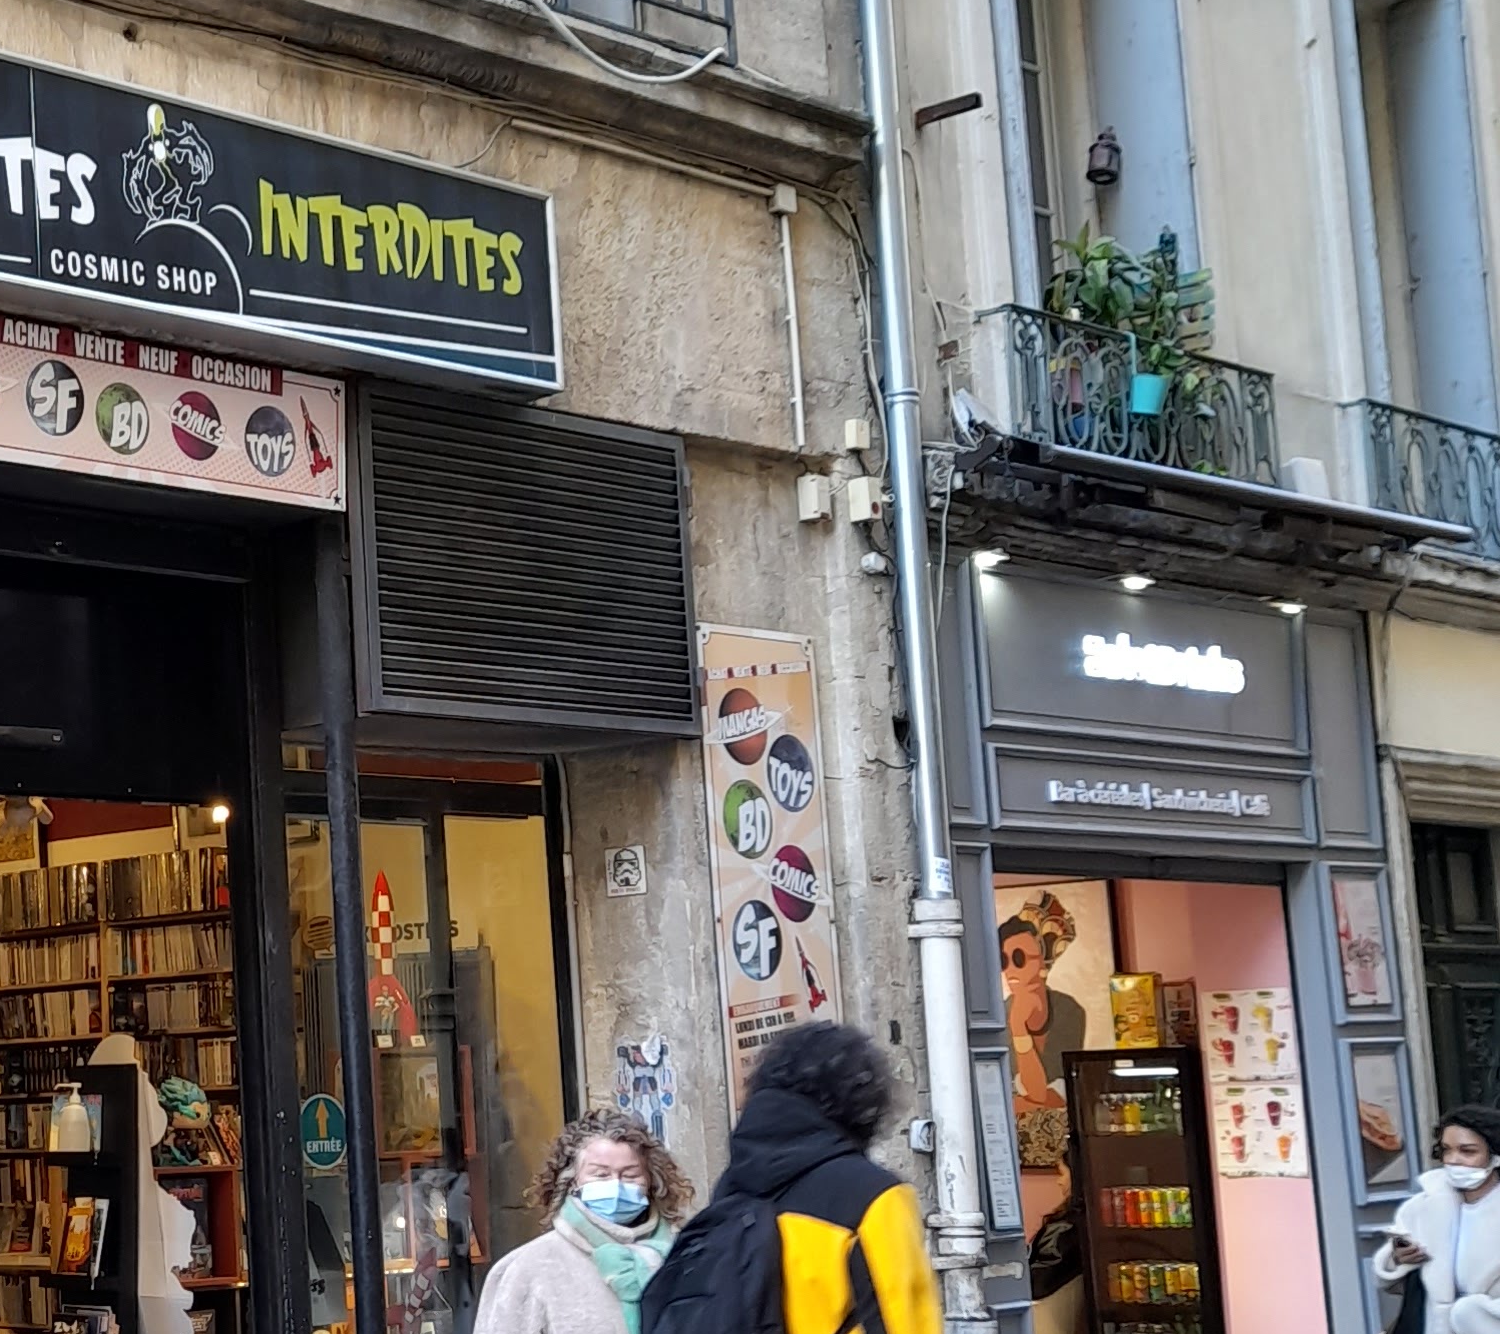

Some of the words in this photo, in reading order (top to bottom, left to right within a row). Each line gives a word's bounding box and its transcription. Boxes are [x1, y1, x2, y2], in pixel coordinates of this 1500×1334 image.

[258, 177, 524, 297] INTERDITES
[50, 249, 146, 287] COSMIC
[157, 264, 218, 296] SHOP
[3, 318, 60, 351] ACHAT
[74, 334, 125, 365] VENTE
[138, 345, 179, 374] NEUF
[192, 355, 272, 392] OCCASION
[29, 362, 80, 434] SF
[109, 401, 149, 451] BD
[169, 400, 226, 447] COMICS
[246, 431, 295, 473] TOYS
[718, 704, 767, 740] MANGAS
[769, 756, 814, 809] TOYS
[738, 797, 771, 853] BD
[767, 857, 820, 898] COMICS
[735, 903, 779, 978] SF
[306, 1136, 342, 1154] ENTRÉE
